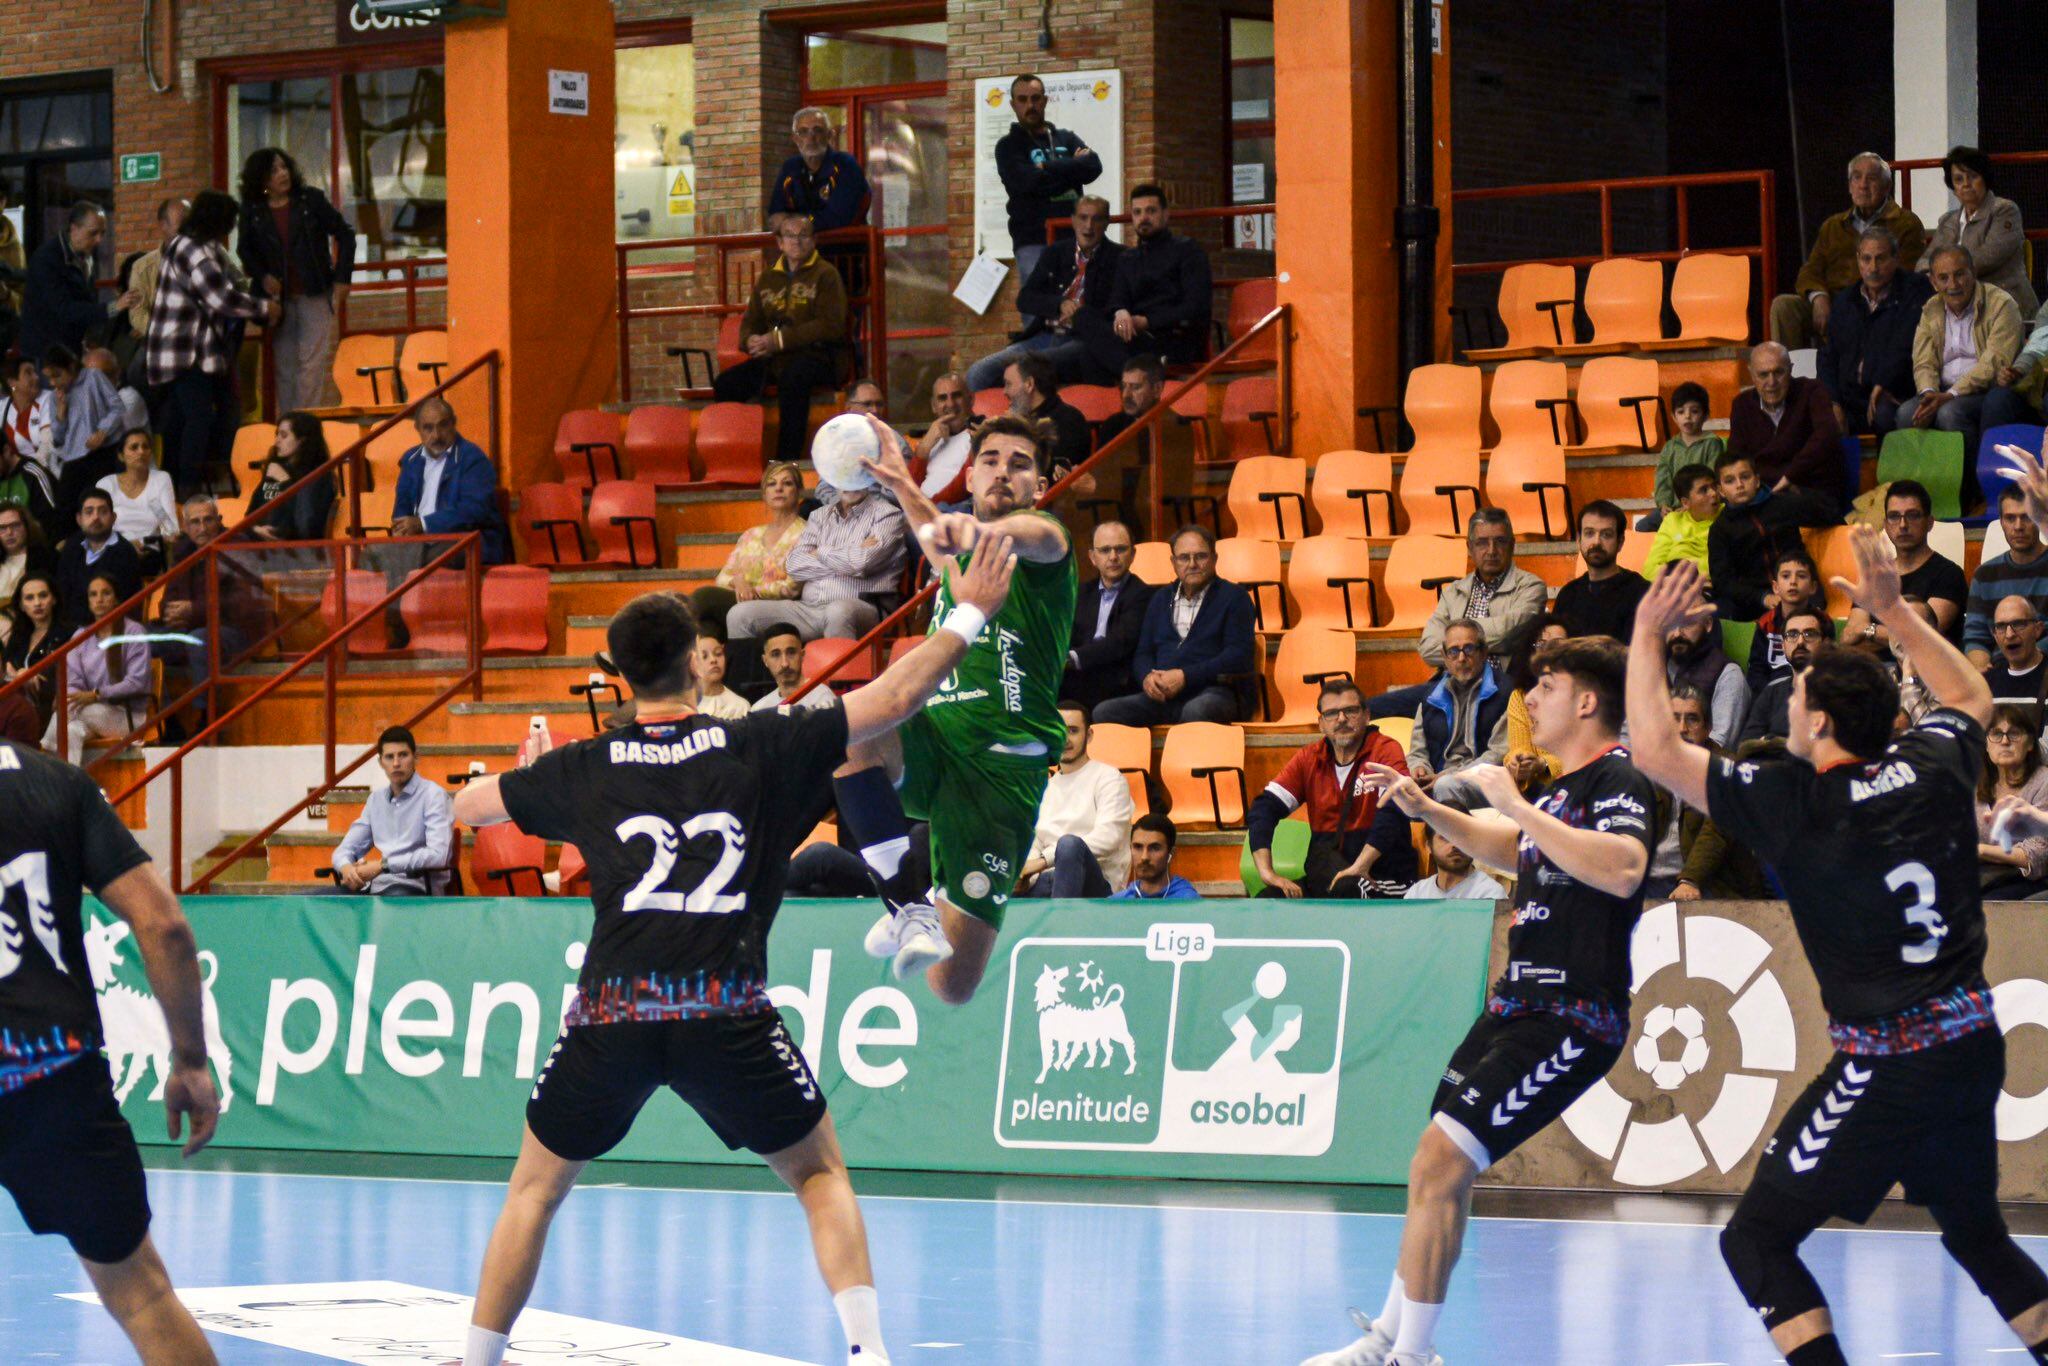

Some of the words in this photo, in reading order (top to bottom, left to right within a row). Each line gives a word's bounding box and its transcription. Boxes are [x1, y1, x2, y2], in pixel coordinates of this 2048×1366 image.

[609, 726, 727, 765] BASUALDO
[308, 804, 327, 817] VES
[614, 811, 747, 914] 22
[1884, 861, 1949, 964] 3
[1154, 931, 1206, 956] Liga
[1011, 1092, 1150, 1127] plenitude
[1190, 1092, 1306, 1127] asobal
